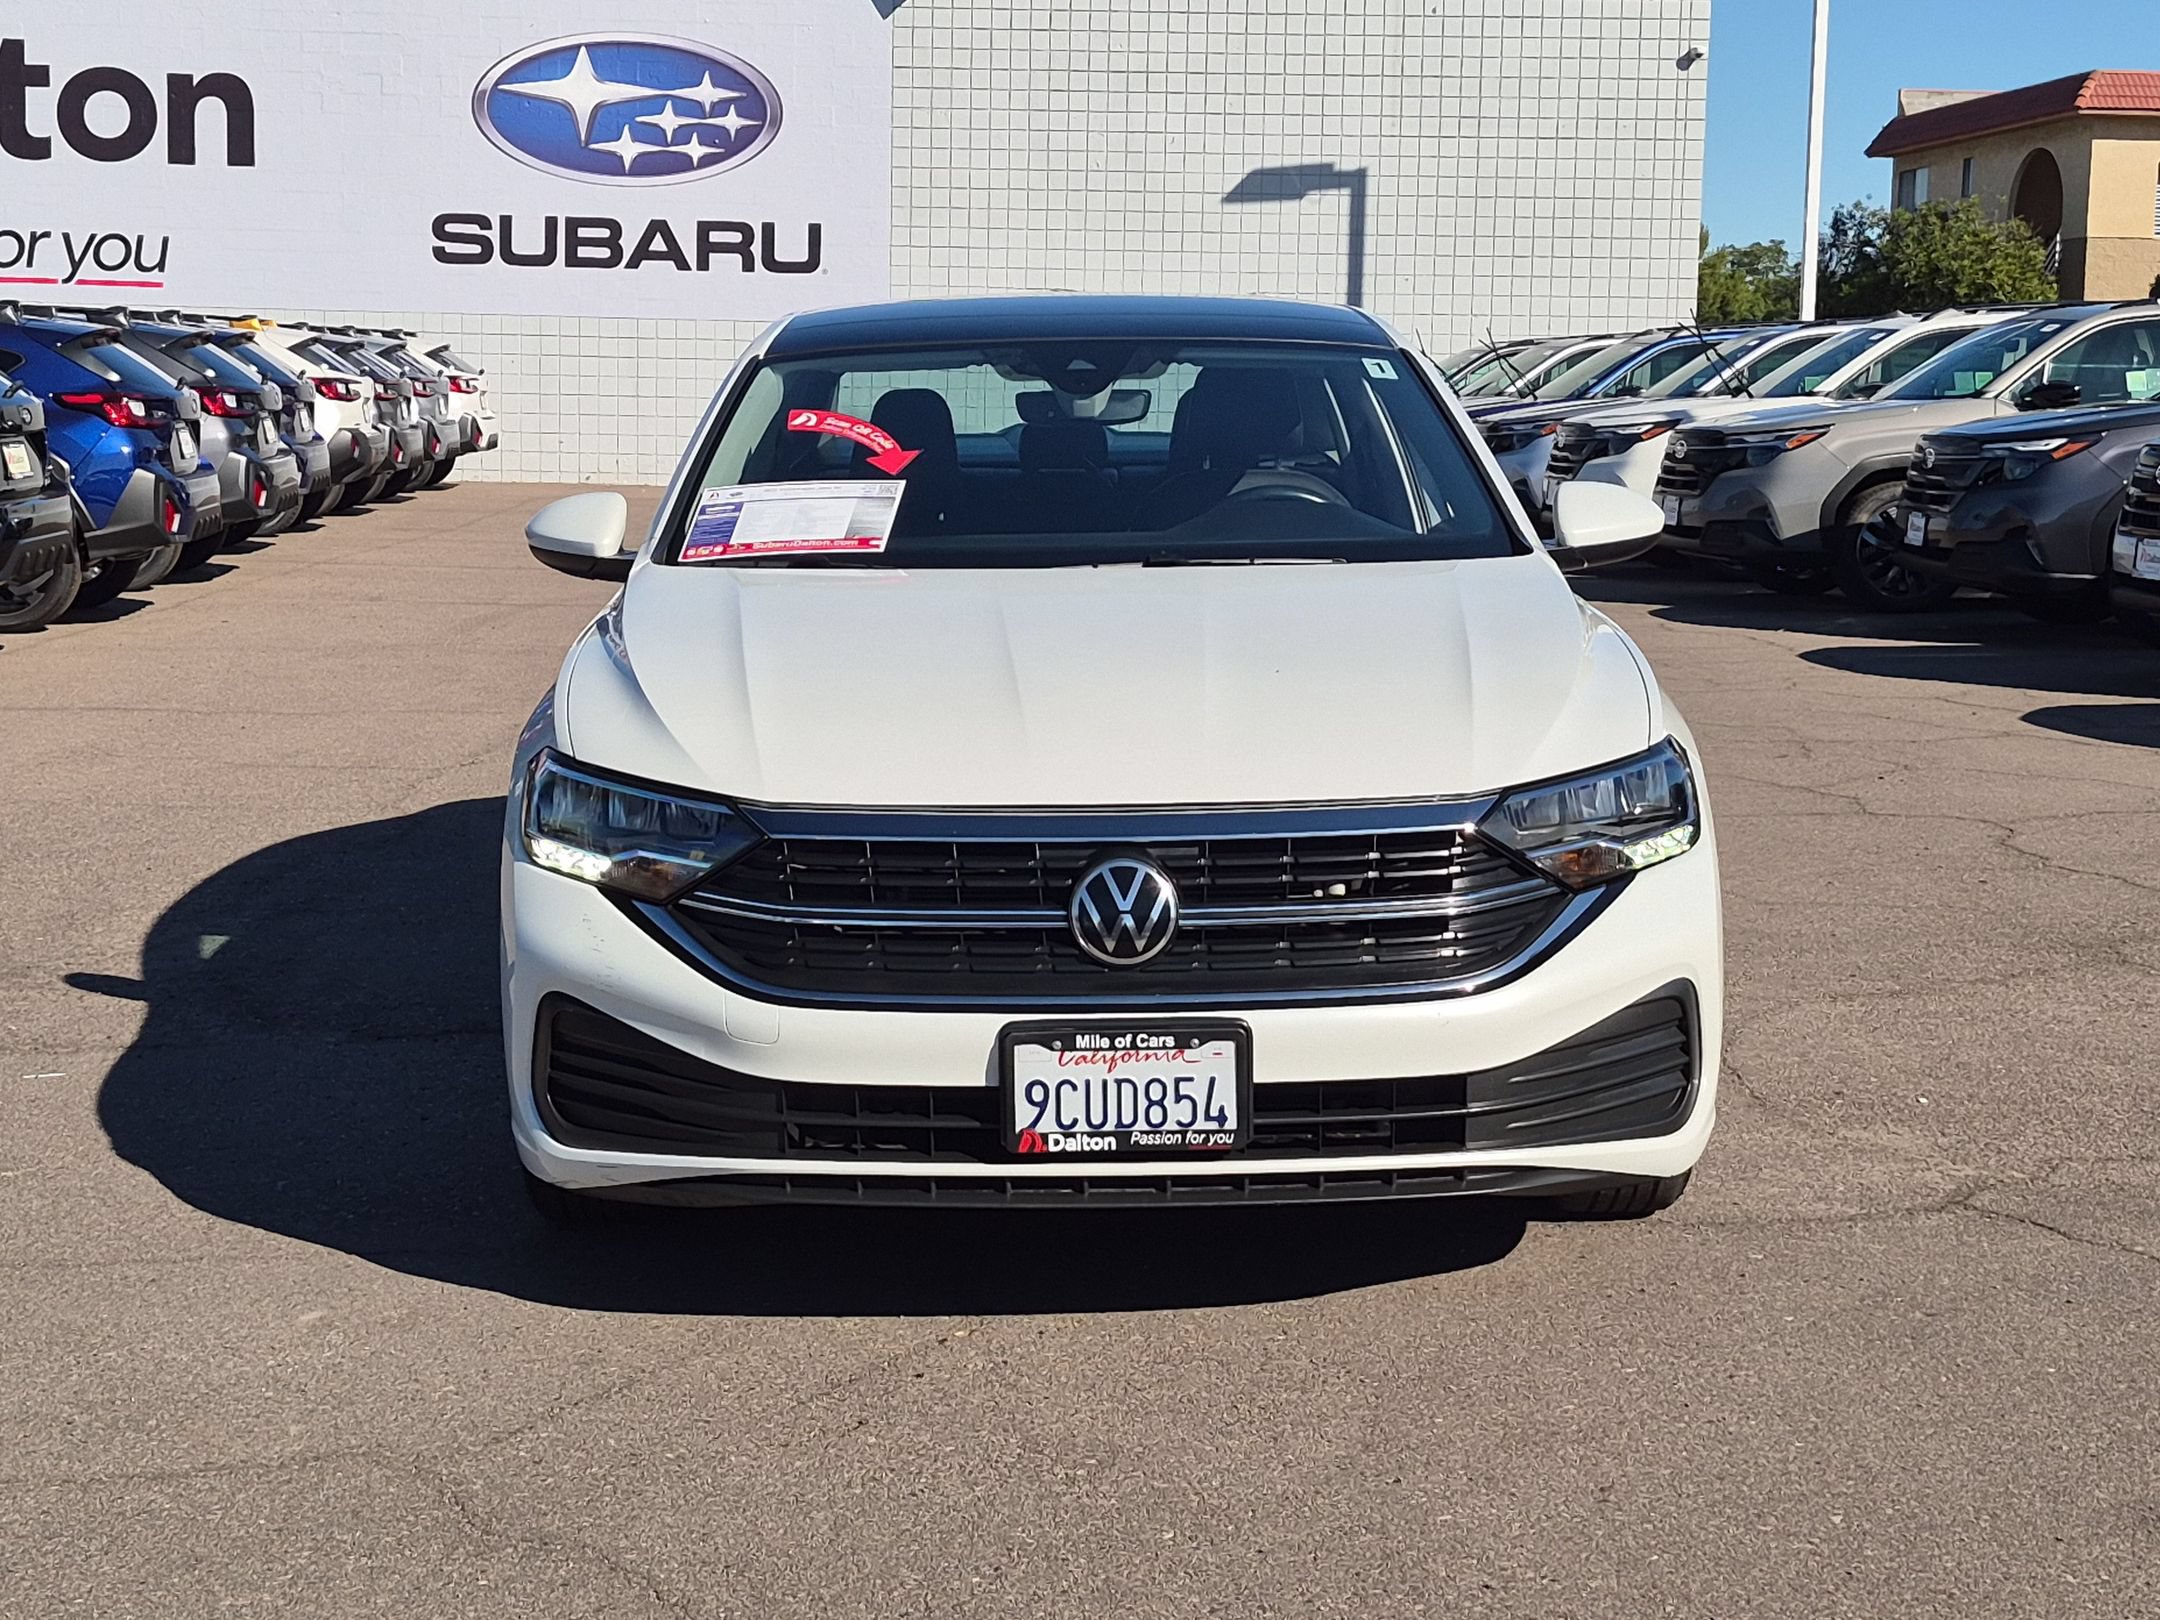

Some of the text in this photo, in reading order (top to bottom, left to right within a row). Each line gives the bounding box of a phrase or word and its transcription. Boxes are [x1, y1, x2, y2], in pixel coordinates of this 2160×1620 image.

[61, 231, 169, 284] you
[431, 212, 822, 274] SUBARU
[1075, 1033, 1176, 1049] Mile of Cars
[1024, 1076, 1229, 1131] 9CUD854
[1048, 1131, 1235, 1152] Dalton Passion for you
